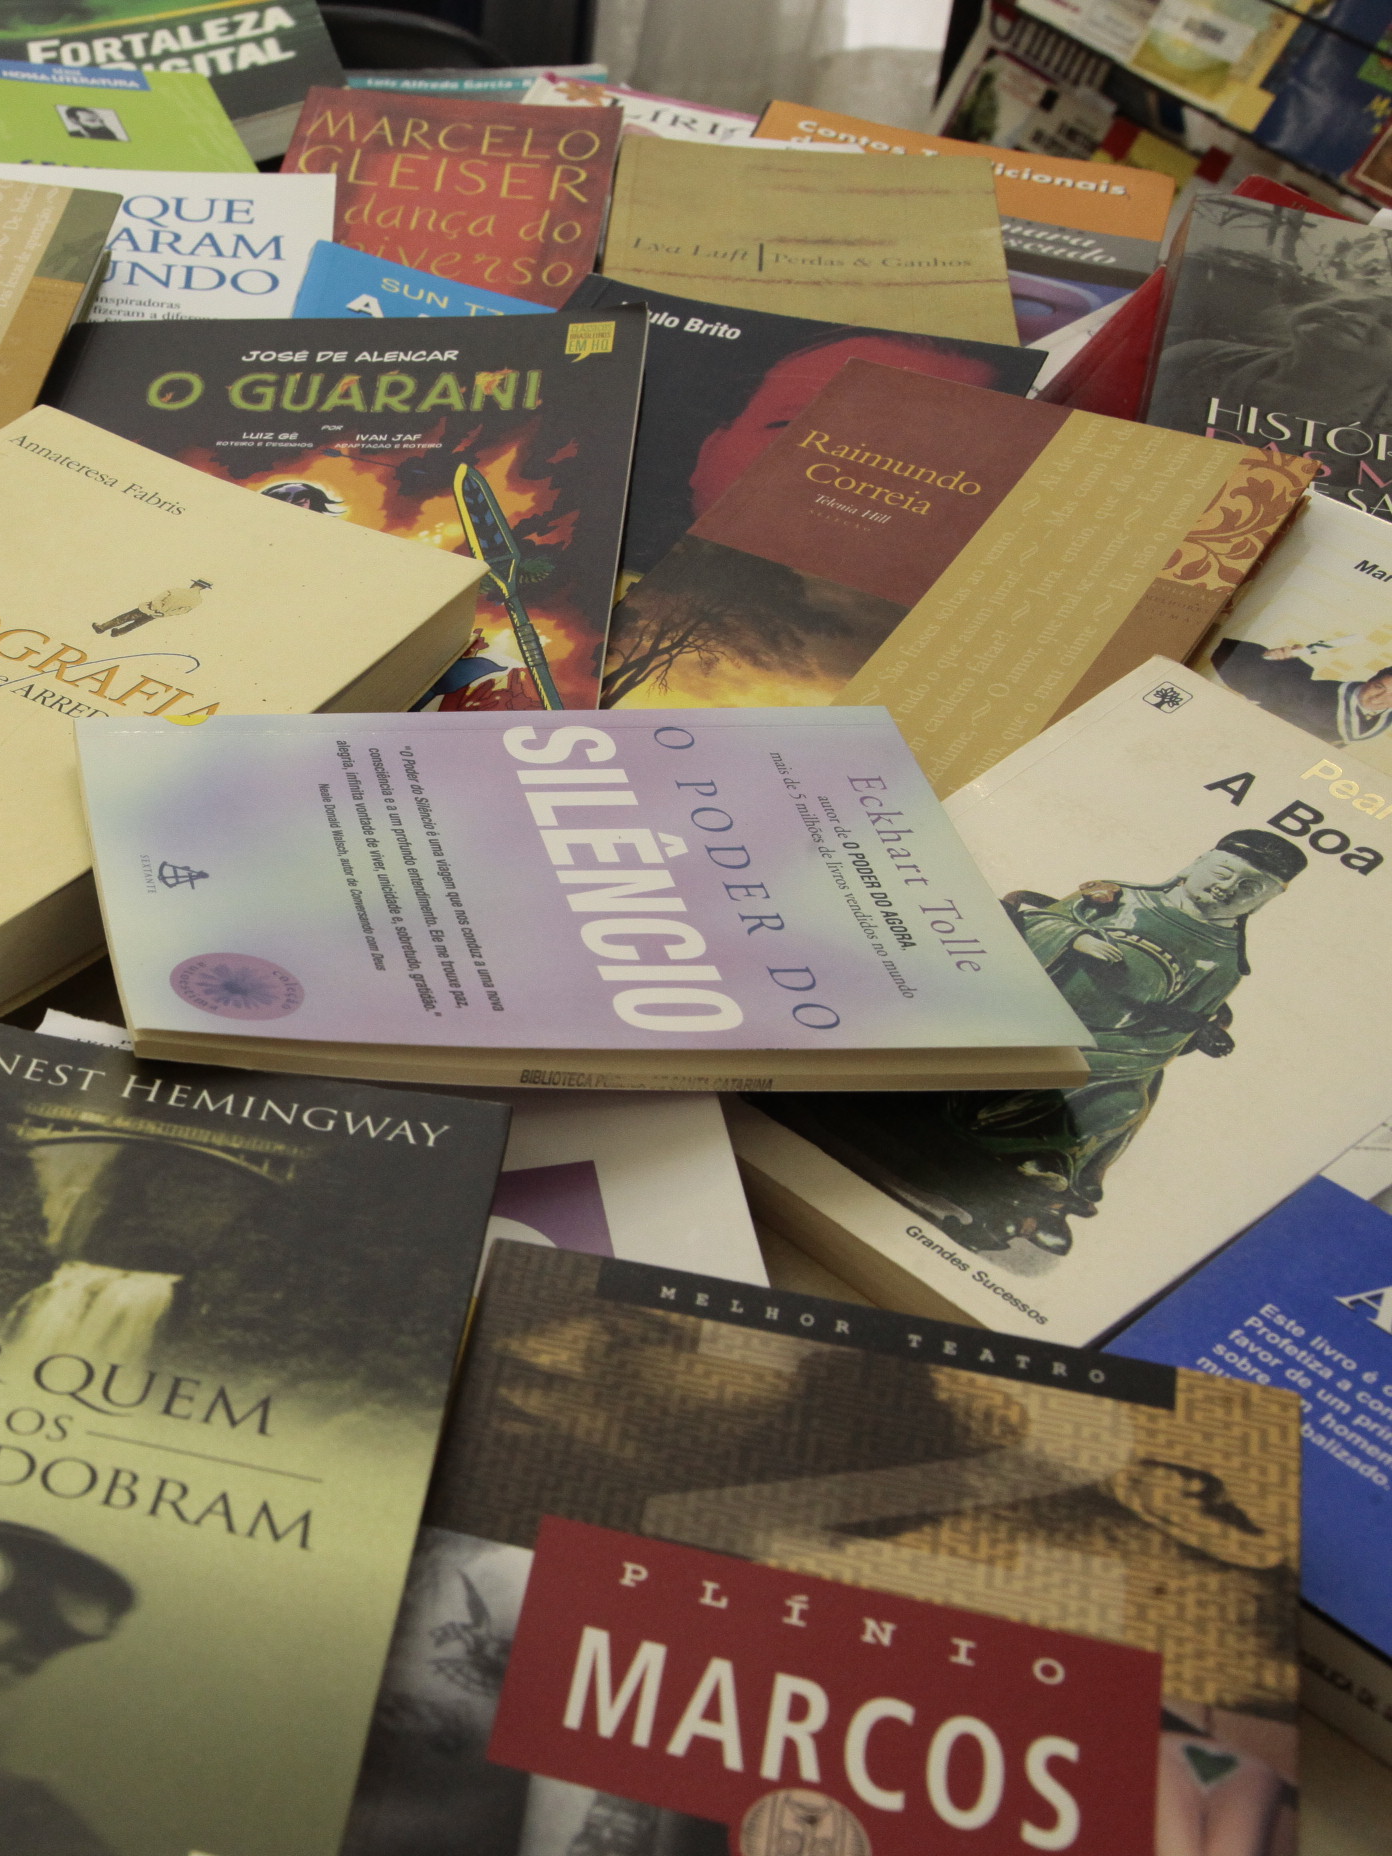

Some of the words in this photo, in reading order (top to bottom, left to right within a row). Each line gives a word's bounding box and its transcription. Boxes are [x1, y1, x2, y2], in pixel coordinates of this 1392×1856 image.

[307, 110, 600, 161] MARCELO
[798, 119, 907, 155] Contos
[298, 145, 588, 203] GLEISER
[123, 195, 255, 228] QUE
[344, 193, 496, 239] dança
[520, 208, 581, 243] do
[381, 278, 448, 309] SUN
[683, 316, 742, 340] Brito
[242, 350, 308, 362] JOSÉ
[316, 351, 348, 363] DE
[355, 350, 459, 363] ALENCAR
[147, 371, 205, 411] O
[226, 369, 542, 413] GUARANI
[242, 432, 277, 441] LUIZ
[280, 430, 299, 440] GÊ
[356, 433, 388, 442] IVAN
[390, 433, 422, 442] JAF
[8, 431, 120, 489] Annateresa
[123, 479, 186, 518] Fabris
[798, 429, 982, 497] Raimundo
[805, 462, 933, 518] Correia
[861, 509, 892, 525] Hill
[654, 726, 695, 750] O
[769, 751, 790, 778] mais
[784, 777, 800, 793] de
[336, 740, 354, 771] alegria,
[378, 873, 401, 917] unicidade
[796, 802, 825, 845] milhões
[818, 795, 841, 823] autor
[1203, 771, 1257, 807] A
[1266, 798, 1386, 878] Boa
[368, 747, 395, 797] consciência
[397, 827, 416, 866] profundo
[407, 867, 437, 927] entendimento.
[818, 845, 834, 860] de
[834, 825, 851, 840] de
[140, 854, 157, 893] SEXTANTE
[414, 795, 435, 831] Silêncio
[435, 855, 457, 890] viagem
[461, 927, 484, 960] conduz
[503, 724, 744, 1033] SILÊNCIO
[674, 779, 786, 937] PODER
[825, 861, 850, 891] livros
[846, 852, 882, 889] PODER
[846, 775, 930, 888] Eckhart
[918, 898, 988, 973] Tolle
[845, 891, 878, 942] vendidos
[870, 889, 893, 909] DO
[871, 941, 889, 958] no
[879, 907, 917, 951] AGORA,
[766, 965, 841, 1030] DO
[881, 958, 914, 1000] mundo
[519, 1068, 594, 1088] BIBLIOTECA
[120, 1073, 453, 1150] HEMINGWAY
[905, 1223, 973, 1274] Grandes
[971, 1268, 1050, 1328] Sucessos
[658, 1283, 851, 1337] MELHOR
[907, 1333, 1108, 1385] TEATRO
[1243, 1315, 1334, 1381] Profetiza
[1259, 1302, 1307, 1338] Este
[1309, 1335, 1358, 1372] livro
[1212, 1342, 1271, 1385] sobre
[1228, 1329, 1284, 1367] favor
[1285, 1366, 1314, 1389] de
[1315, 1387, 1353, 1416] um
[33, 1352, 275, 1438] QUEM
[4, 1406, 75, 1445] OS
[619, 1559, 1067, 1688] PLÍNIO
[561, 1625, 1082, 1853] MARCOS
